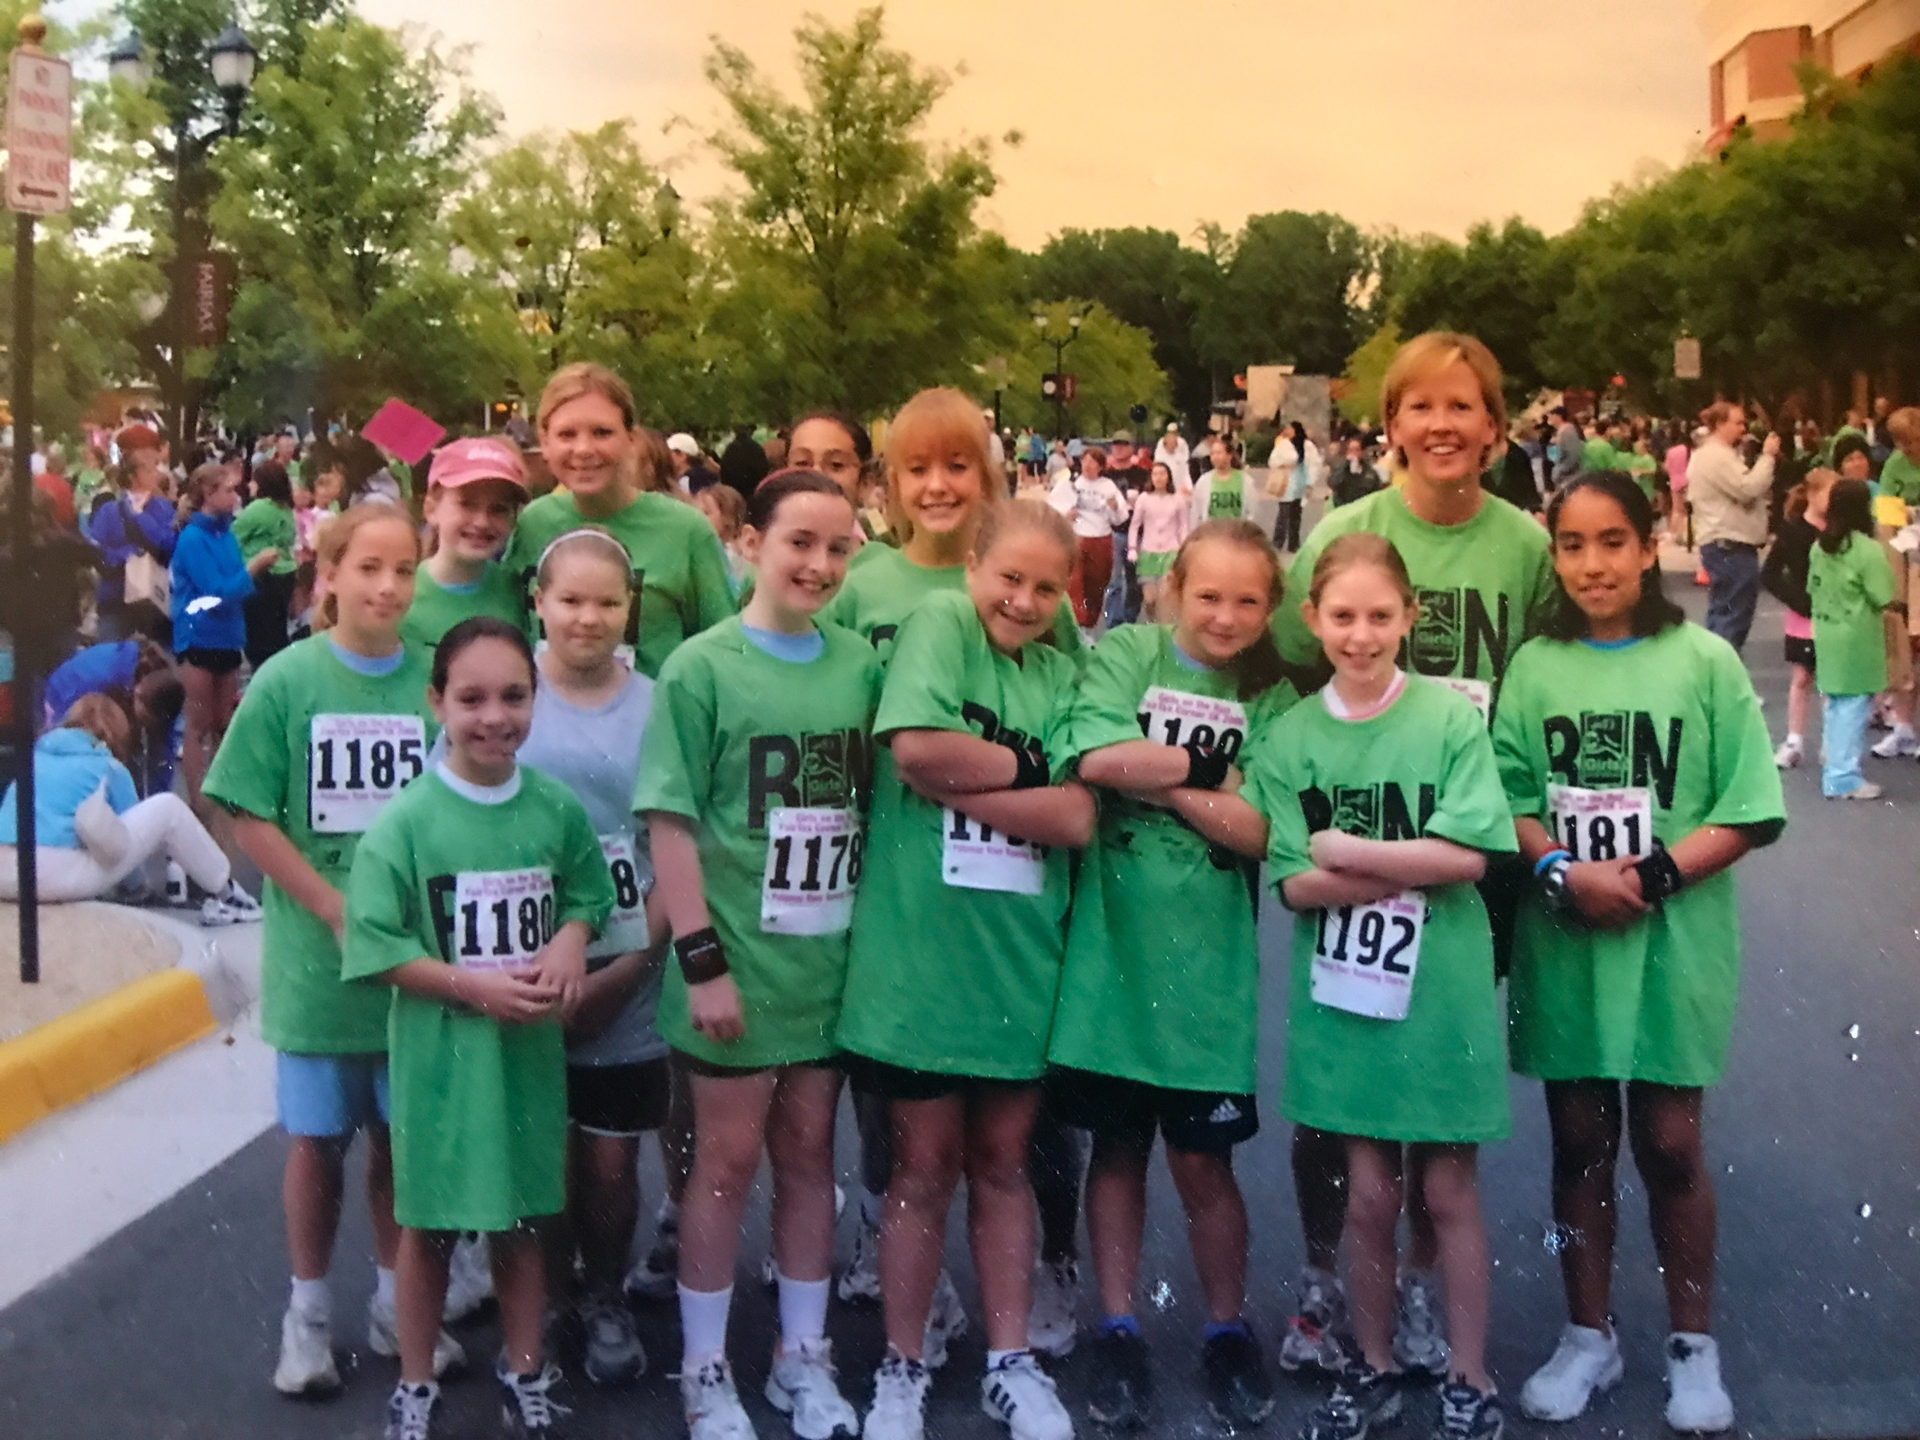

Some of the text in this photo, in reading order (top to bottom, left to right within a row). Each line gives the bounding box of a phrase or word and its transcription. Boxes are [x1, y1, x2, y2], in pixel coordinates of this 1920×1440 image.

[317, 738, 423, 789] 1185
[768, 831, 863, 891] 1178
[460, 893, 553, 956] 1180
[1316, 905, 1416, 975] 1192
